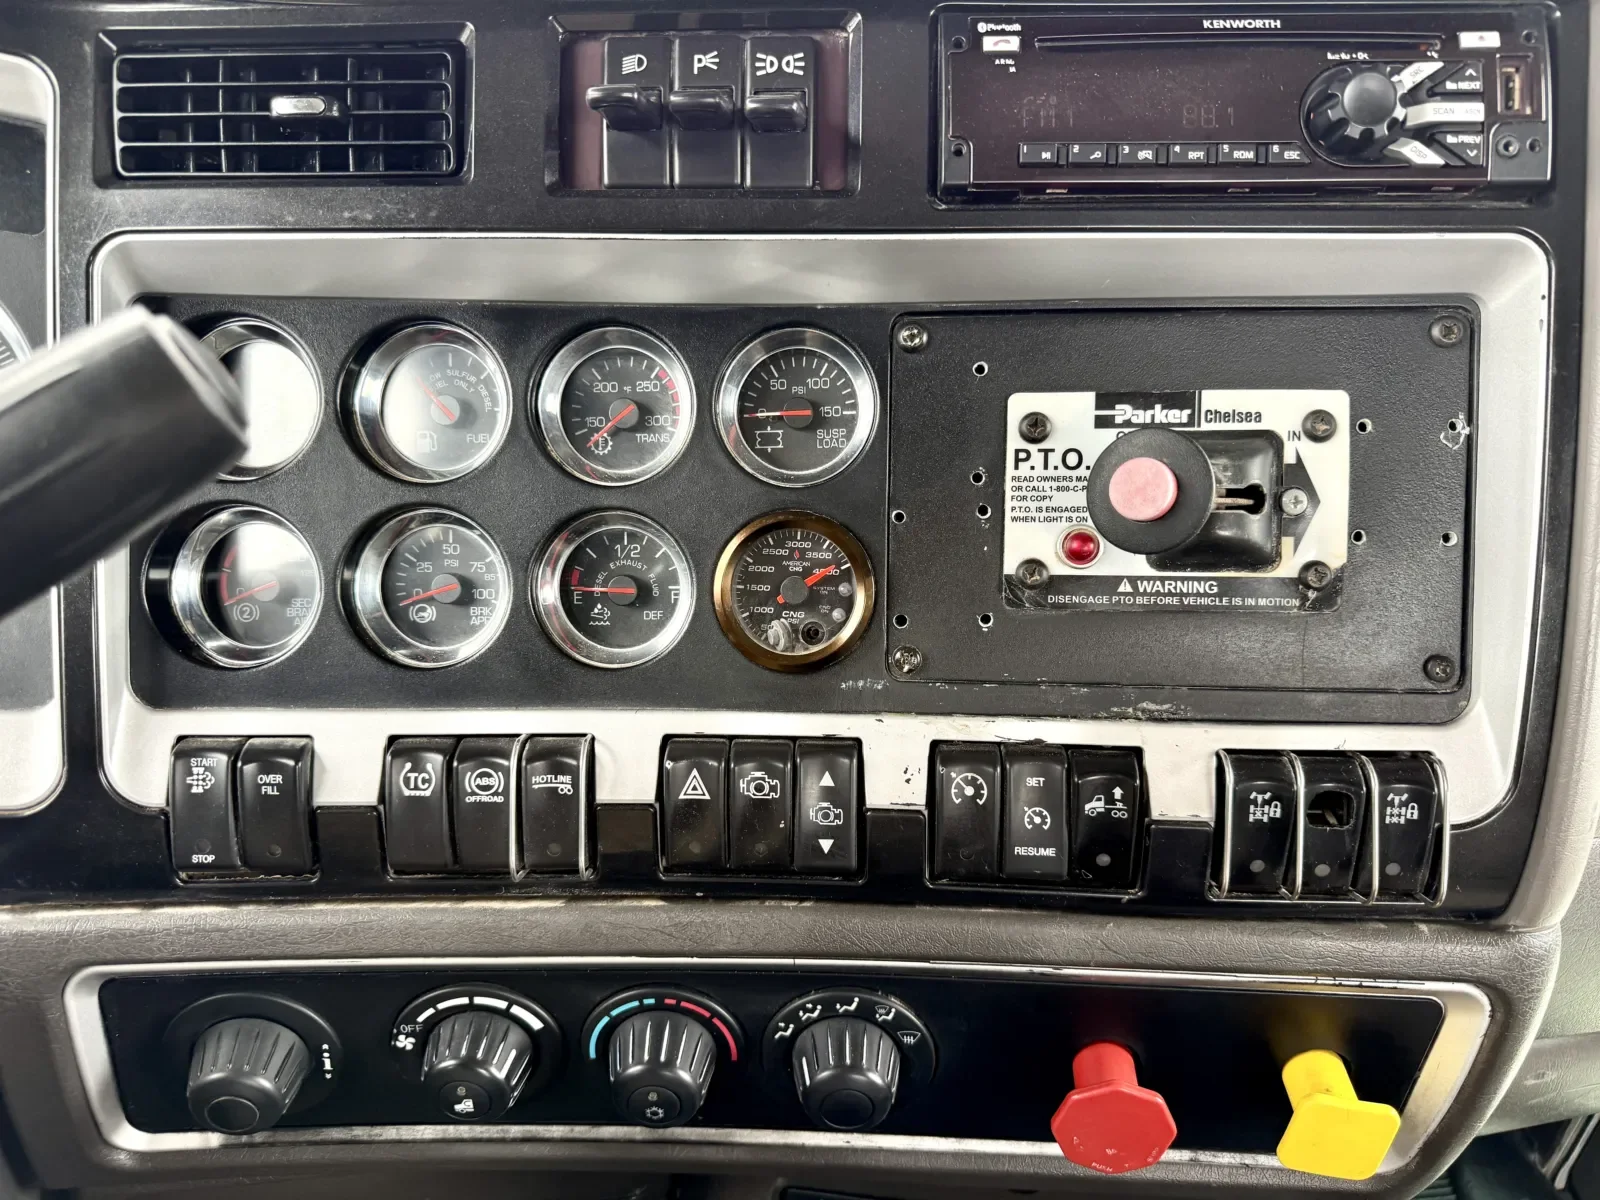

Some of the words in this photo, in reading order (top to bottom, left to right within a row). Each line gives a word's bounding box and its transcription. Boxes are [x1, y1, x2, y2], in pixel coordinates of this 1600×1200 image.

[1202, 19, 1281, 29] KENWORTH
[1458, 81, 1481, 90] NEXT
[1433, 107, 1455, 115] SCAN
[1458, 135, 1481, 144] PREV
[1073, 145, 1080, 153] 2
[1123, 145, 1130, 154] 3
[1174, 145, 1181, 153] 4
[1223, 145, 1229, 153] 5
[1272, 145, 1279, 153] 6
[1188, 152, 1205, 160] RPT
[1284, 151, 1301, 160] ESC
[453, 379, 475, 393] ONLY
[593, 381, 619, 393] 200
[636, 381, 660, 392] 250
[769, 379, 787, 390] 50
[805, 378, 830, 389] 100
[446, 369, 477, 384] SULFUR
[478, 384, 493, 413] DIESEL
[791, 386, 807, 395] PSI
[819, 406, 842, 417] 150
[1114, 404, 1192, 424] Parker
[1204, 409, 1262, 424] Chelsea
[585, 416, 606, 427] 150
[644, 415, 671, 427] 300
[635, 433, 670, 443] TRANS
[816, 429, 847, 439] SUSP
[1287, 430, 1301, 442] IN
[816, 439, 847, 449] LOAD
[1013, 447, 1091, 471] P.T.O.
[1011, 475, 1035, 483] READ
[1036, 475, 1074, 483] OWNERS
[1010, 485, 1024, 493] OR
[1024, 485, 1047, 493] CALL
[1048, 485, 1088, 493] 1-800-C-P
[784, 540, 812, 548] 3000
[443, 544, 460, 555] 50
[614, 544, 641, 559] 1/2
[762, 548, 789, 556] 2500
[805, 551, 832, 559] 3500
[416, 562, 432, 573] 25
[444, 559, 459, 567] PSI
[469, 561, 486, 573] 75
[748, 565, 775, 573] 2000
[609, 559, 648, 571] EXHAUST
[648, 573, 660, 597] FLUID
[746, 584, 771, 592] 1500
[1137, 580, 1218, 593] WARNING
[472, 588, 495, 600] 100
[574, 591, 583, 605] E
[291, 598, 312, 608] SEC
[1047, 595, 1110, 604] DISENGAGE
[1112, 596, 1133, 604] PTO
[1135, 596, 1180, 605] BEFORE
[1182, 597, 1230, 606] VEHICLE
[1231, 597, 1243, 606] IS
[1244, 597, 1256, 606] IN
[1258, 598, 1300, 607] MOTION
[286, 607, 312, 617] BRA
[470, 606, 493, 616] BRK
[643, 610, 664, 620] DEF
[749, 606, 775, 614] 1000
[782, 610, 805, 618] CNG
[190, 757, 218, 767] START
[257, 774, 283, 784] OVER
[407, 772, 430, 789] TC
[474, 776, 496, 786] ABS
[532, 775, 572, 784] HOTLINE
[1026, 777, 1045, 787] SET
[261, 785, 280, 795] FILL
[465, 795, 504, 803] OFFROAD
[1014, 846, 1056, 857] RESUME
[191, 854, 216, 864] STOP
[400, 1023, 424, 1034] OFF
